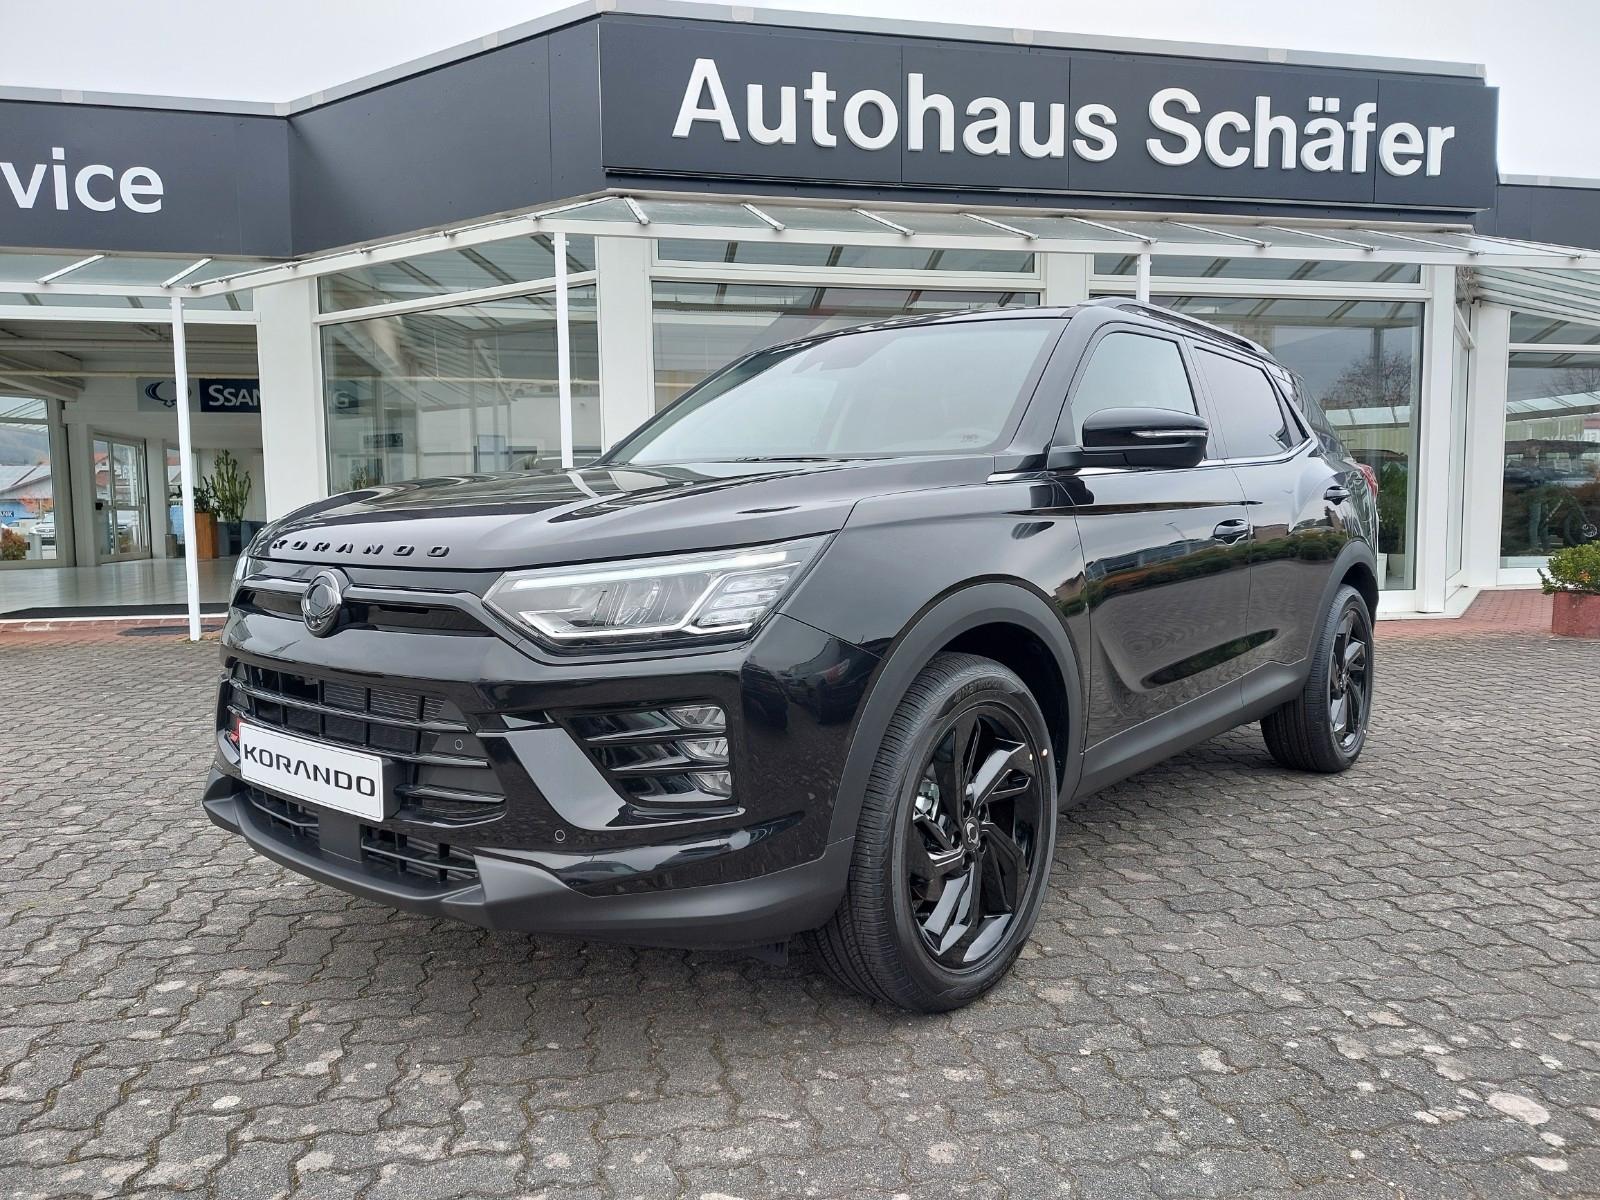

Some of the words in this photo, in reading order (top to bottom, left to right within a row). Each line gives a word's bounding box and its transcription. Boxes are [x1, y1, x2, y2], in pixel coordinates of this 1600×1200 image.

[672, 57, 1119, 163] Autohaus
[1146, 87, 1456, 177] Schäfer
[0, 147, 164, 213] vice
[272, 539, 450, 558] KORANDO
[243, 743, 376, 797] KORANDO
